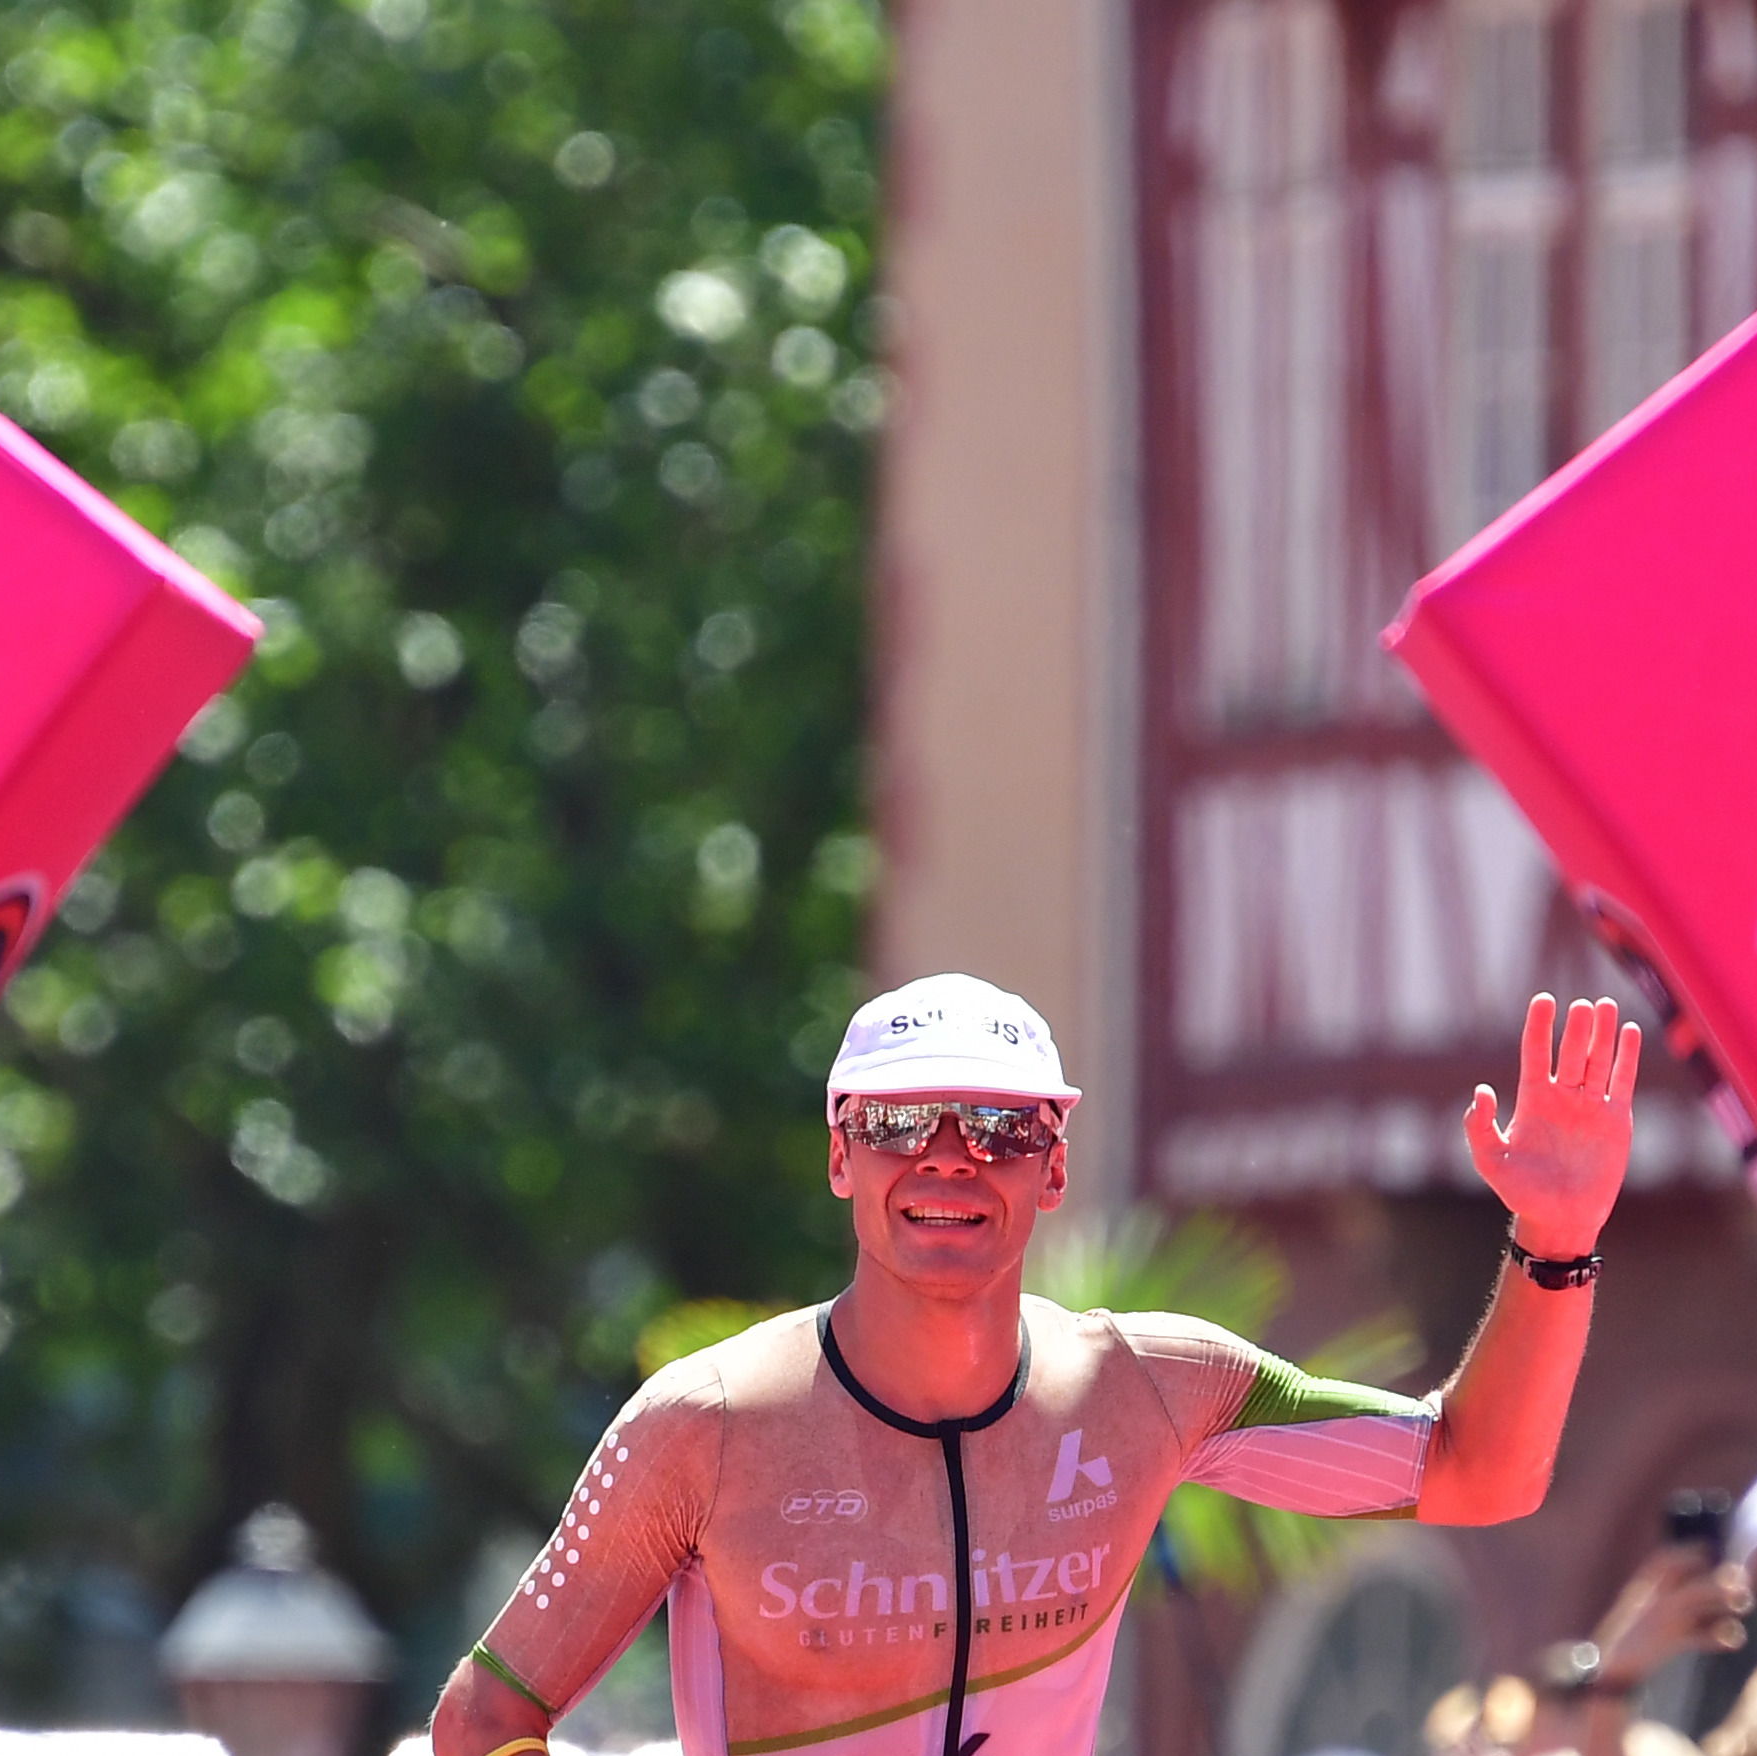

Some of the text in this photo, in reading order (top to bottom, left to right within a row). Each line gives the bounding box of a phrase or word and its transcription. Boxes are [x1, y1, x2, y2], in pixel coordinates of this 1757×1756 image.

[782, 1495, 866, 1519] PTO
[1047, 1489, 1118, 1523] surpas
[758, 1542, 1111, 1620] Schnitzer
